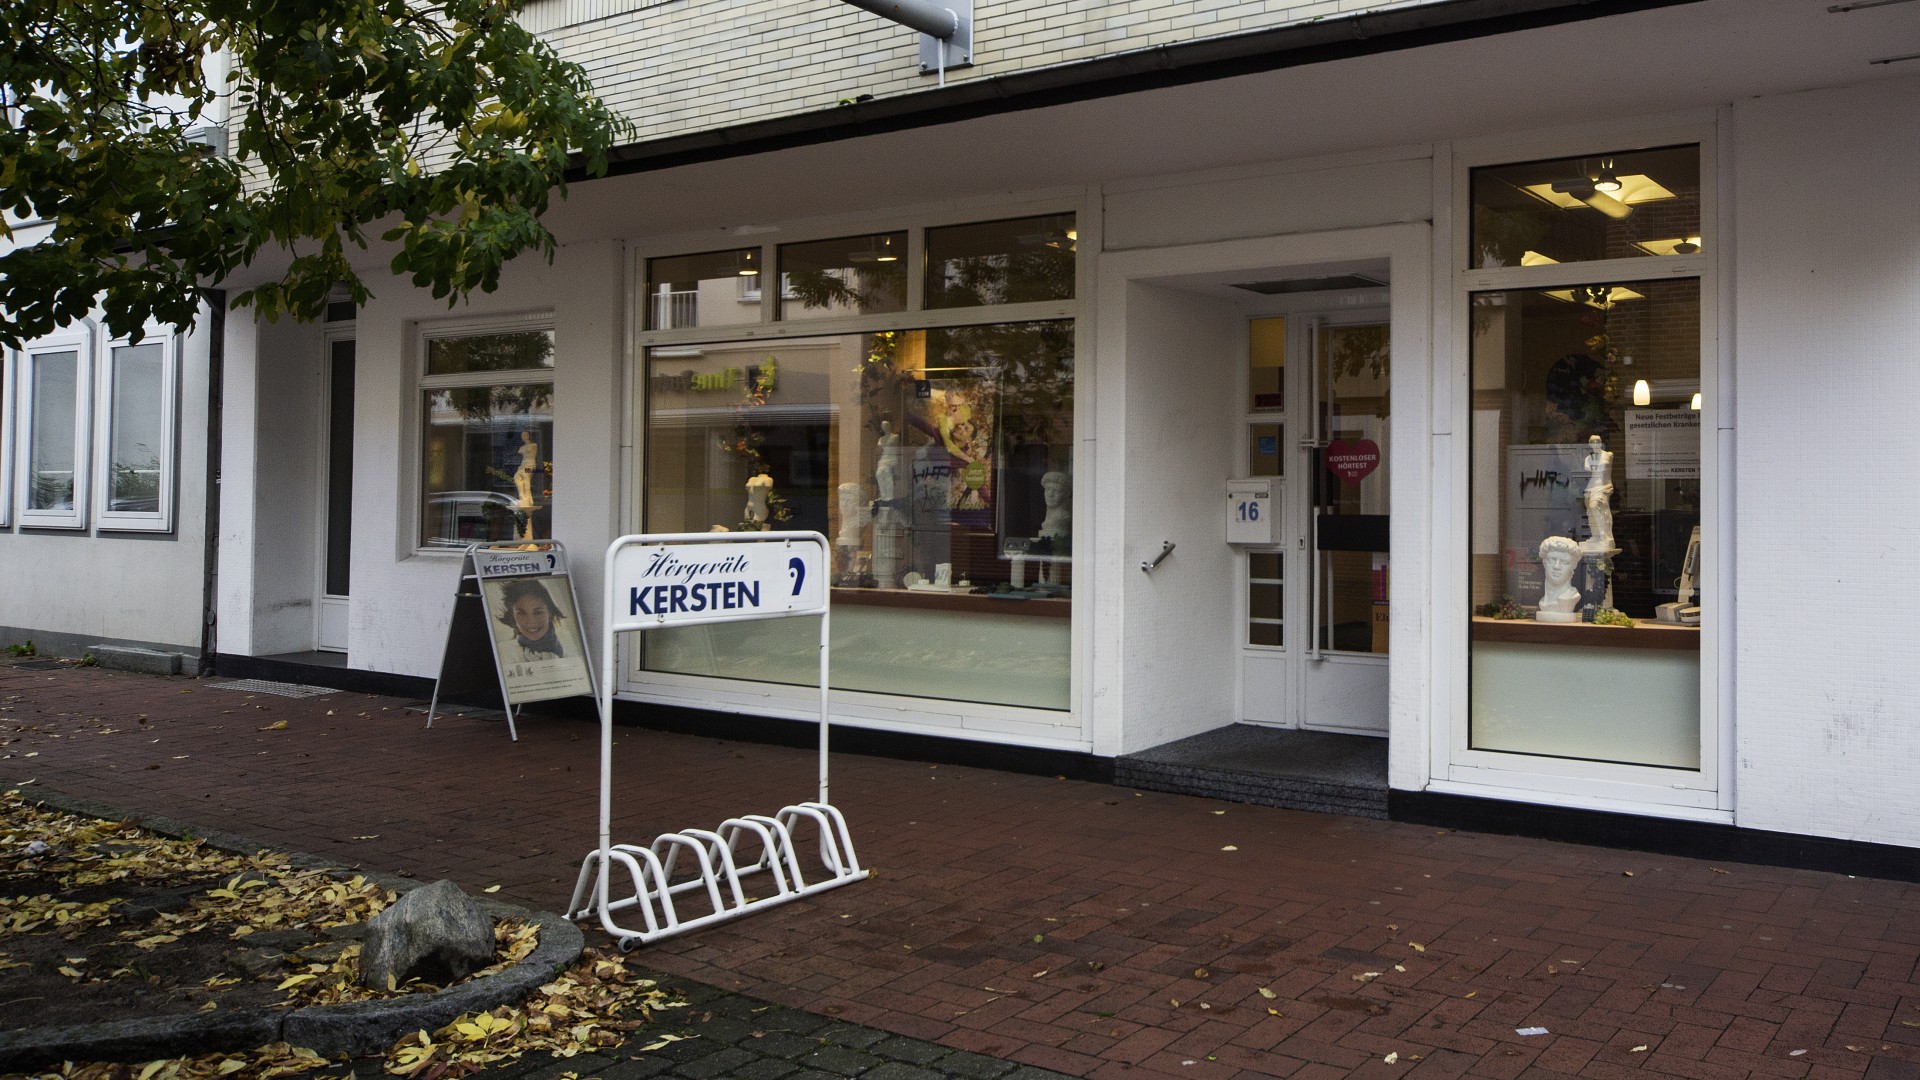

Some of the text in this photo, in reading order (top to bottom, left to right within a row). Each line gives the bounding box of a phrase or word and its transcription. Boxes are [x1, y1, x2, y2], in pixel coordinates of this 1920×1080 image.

[1328, 454, 1377, 462] KOSTENLOSER
[1337, 461, 1368, 469] HÖRTEST
[1238, 501, 1259, 521] 16
[489, 554, 529, 564] Hörgeräte
[484, 563, 540, 575] KERSTEN
[641, 552, 749, 584] Hörgeräte
[629, 580, 760, 616] KERSTEN
